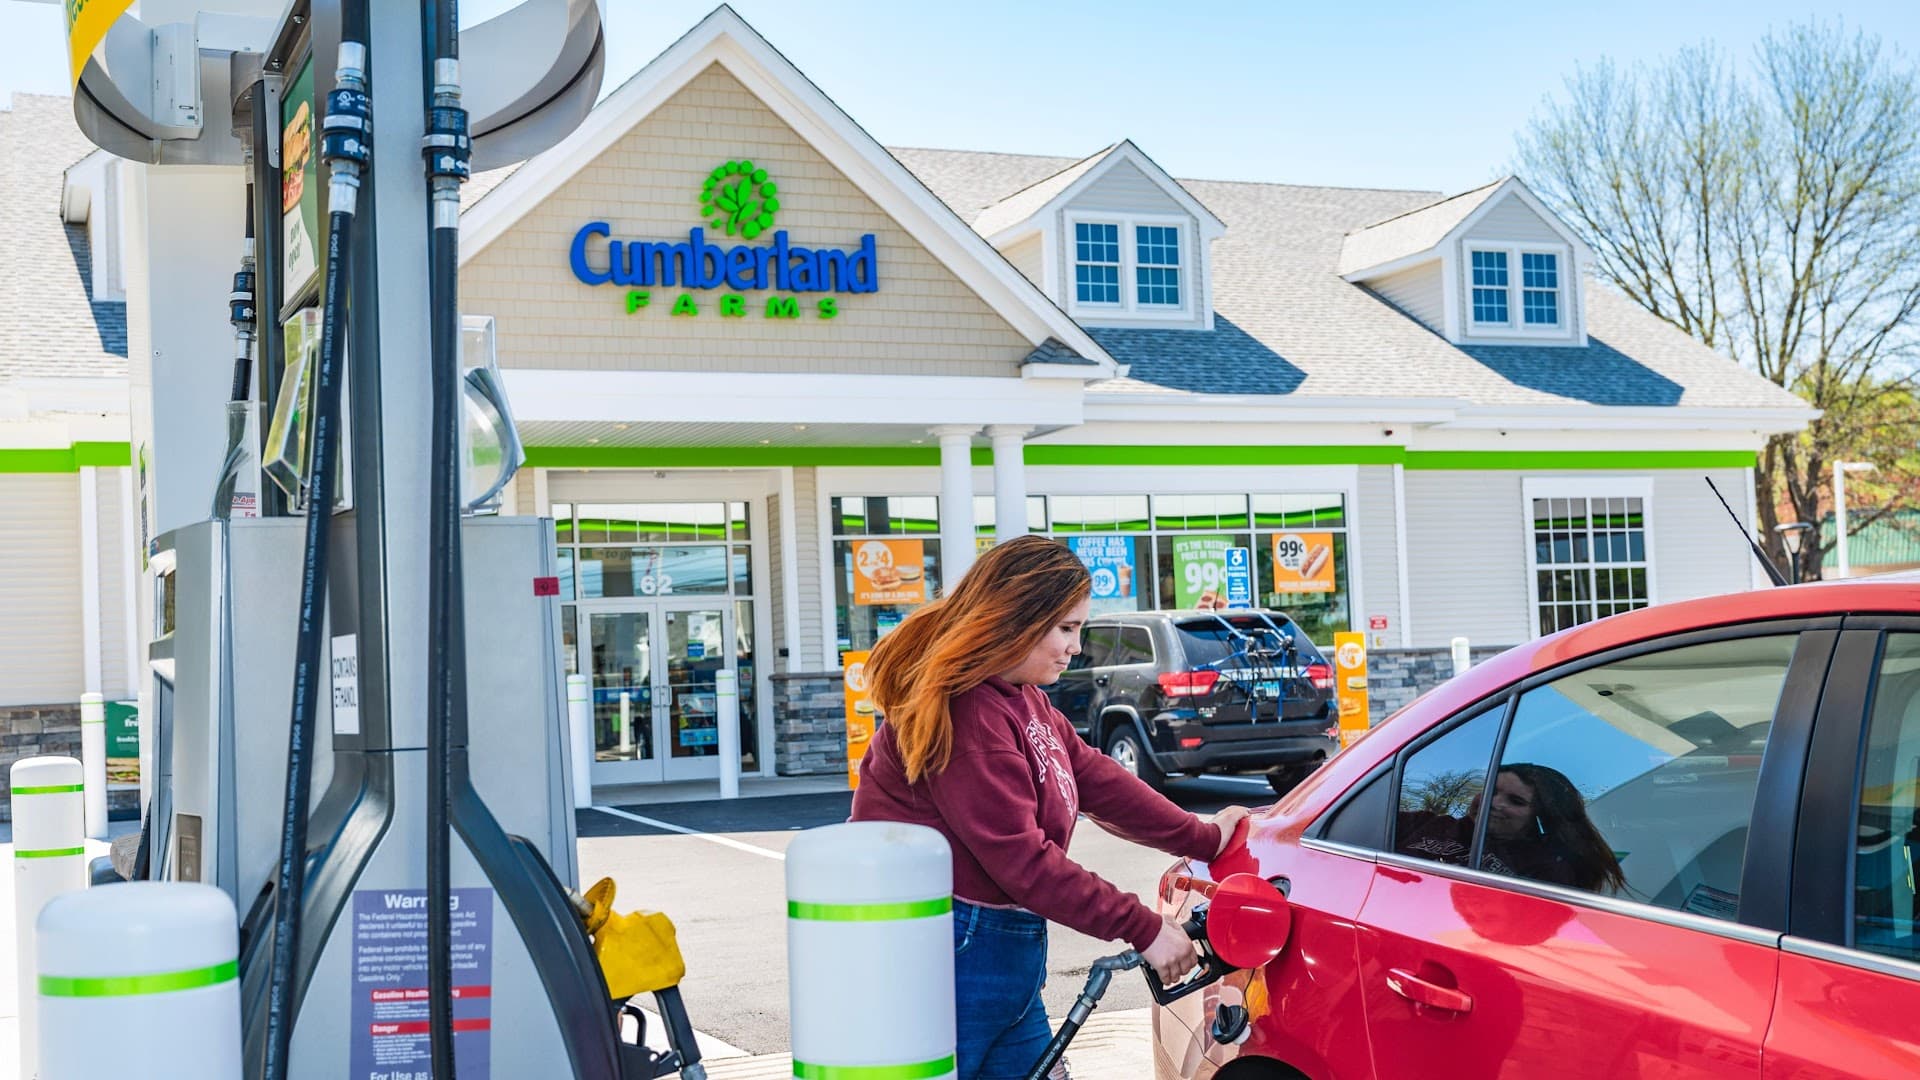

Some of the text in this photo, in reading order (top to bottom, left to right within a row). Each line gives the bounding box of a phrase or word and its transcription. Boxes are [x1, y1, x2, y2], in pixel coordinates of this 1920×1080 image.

[570, 221, 879, 293] Cumberland
[625, 290, 839, 319] FARMS
[1078, 536, 1125, 546] COFFEE HAS
[1076, 547, 1128, 557] NEVER BEEN
[640, 575, 673, 595] 62
[333, 656, 357, 679] CONTAINS
[334, 687, 357, 708] ETHANOL
[384, 894, 460, 911] Warng
[359, 913, 371, 921] The
[372, 912, 394, 921] Federal
[396, 911, 428, 921] Hazardou
[465, 911, 477, 919] Act
[359, 922, 385, 930] declares
[391, 921, 416, 930] unlawful
[371, 930, 402, 939] containers
[359, 945, 381, 954] Federal
[381, 945, 393, 953] law
[395, 943, 420, 954] prohibits
[474, 942, 487, 952] any
[358, 954, 384, 964] gasoline
[384, 953, 416, 963] containing
[383, 962, 401, 971] motor
[358, 973, 385, 982] Gasoline
[372, 990, 404, 1000] Gasoline
[372, 1024, 399, 1034] Danger
[370, 1072, 389, 1080] For
[391, 1071, 412, 1080] Use
